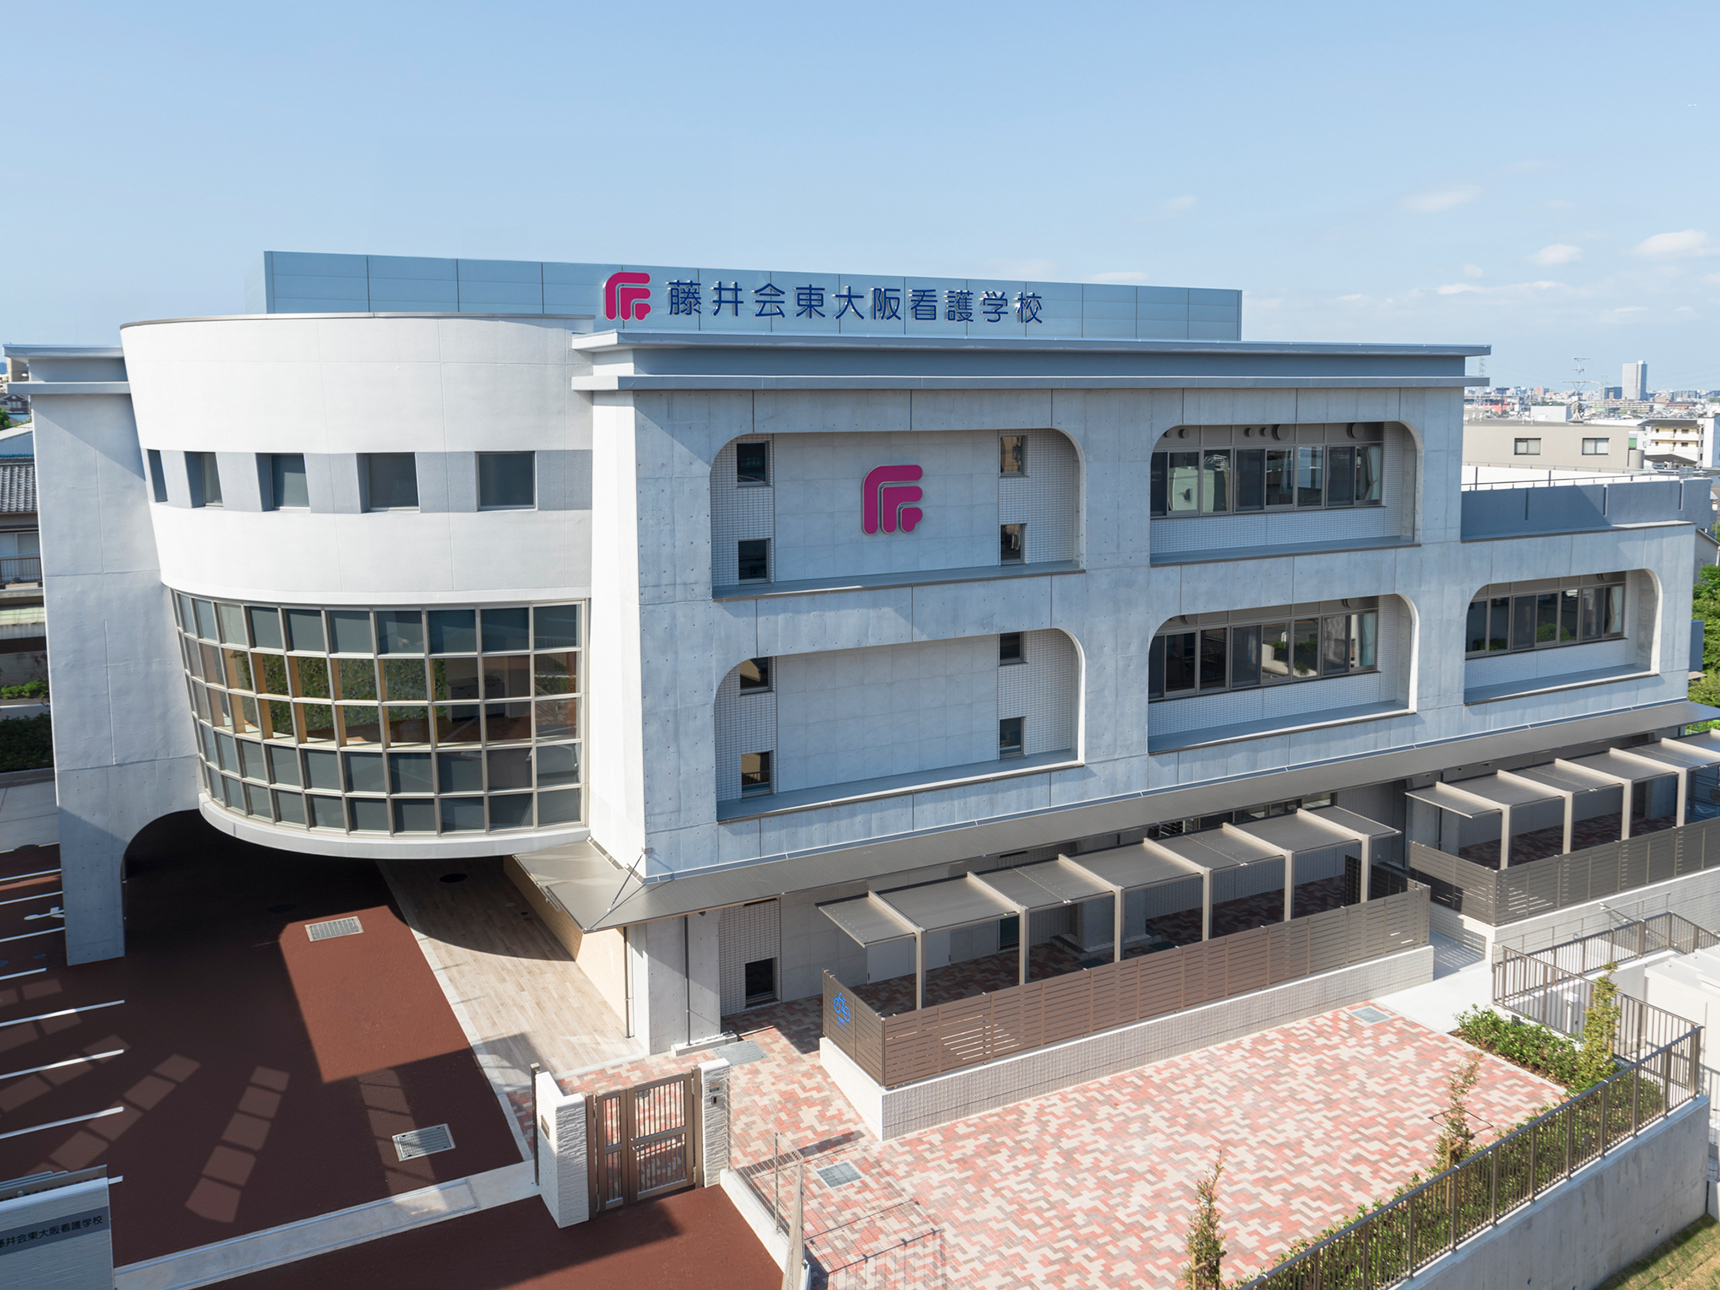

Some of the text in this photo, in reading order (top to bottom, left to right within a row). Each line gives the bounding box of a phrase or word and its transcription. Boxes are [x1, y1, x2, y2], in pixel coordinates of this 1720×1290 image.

[667, 280, 1042, 323] 藤井会東大阪看護学校
